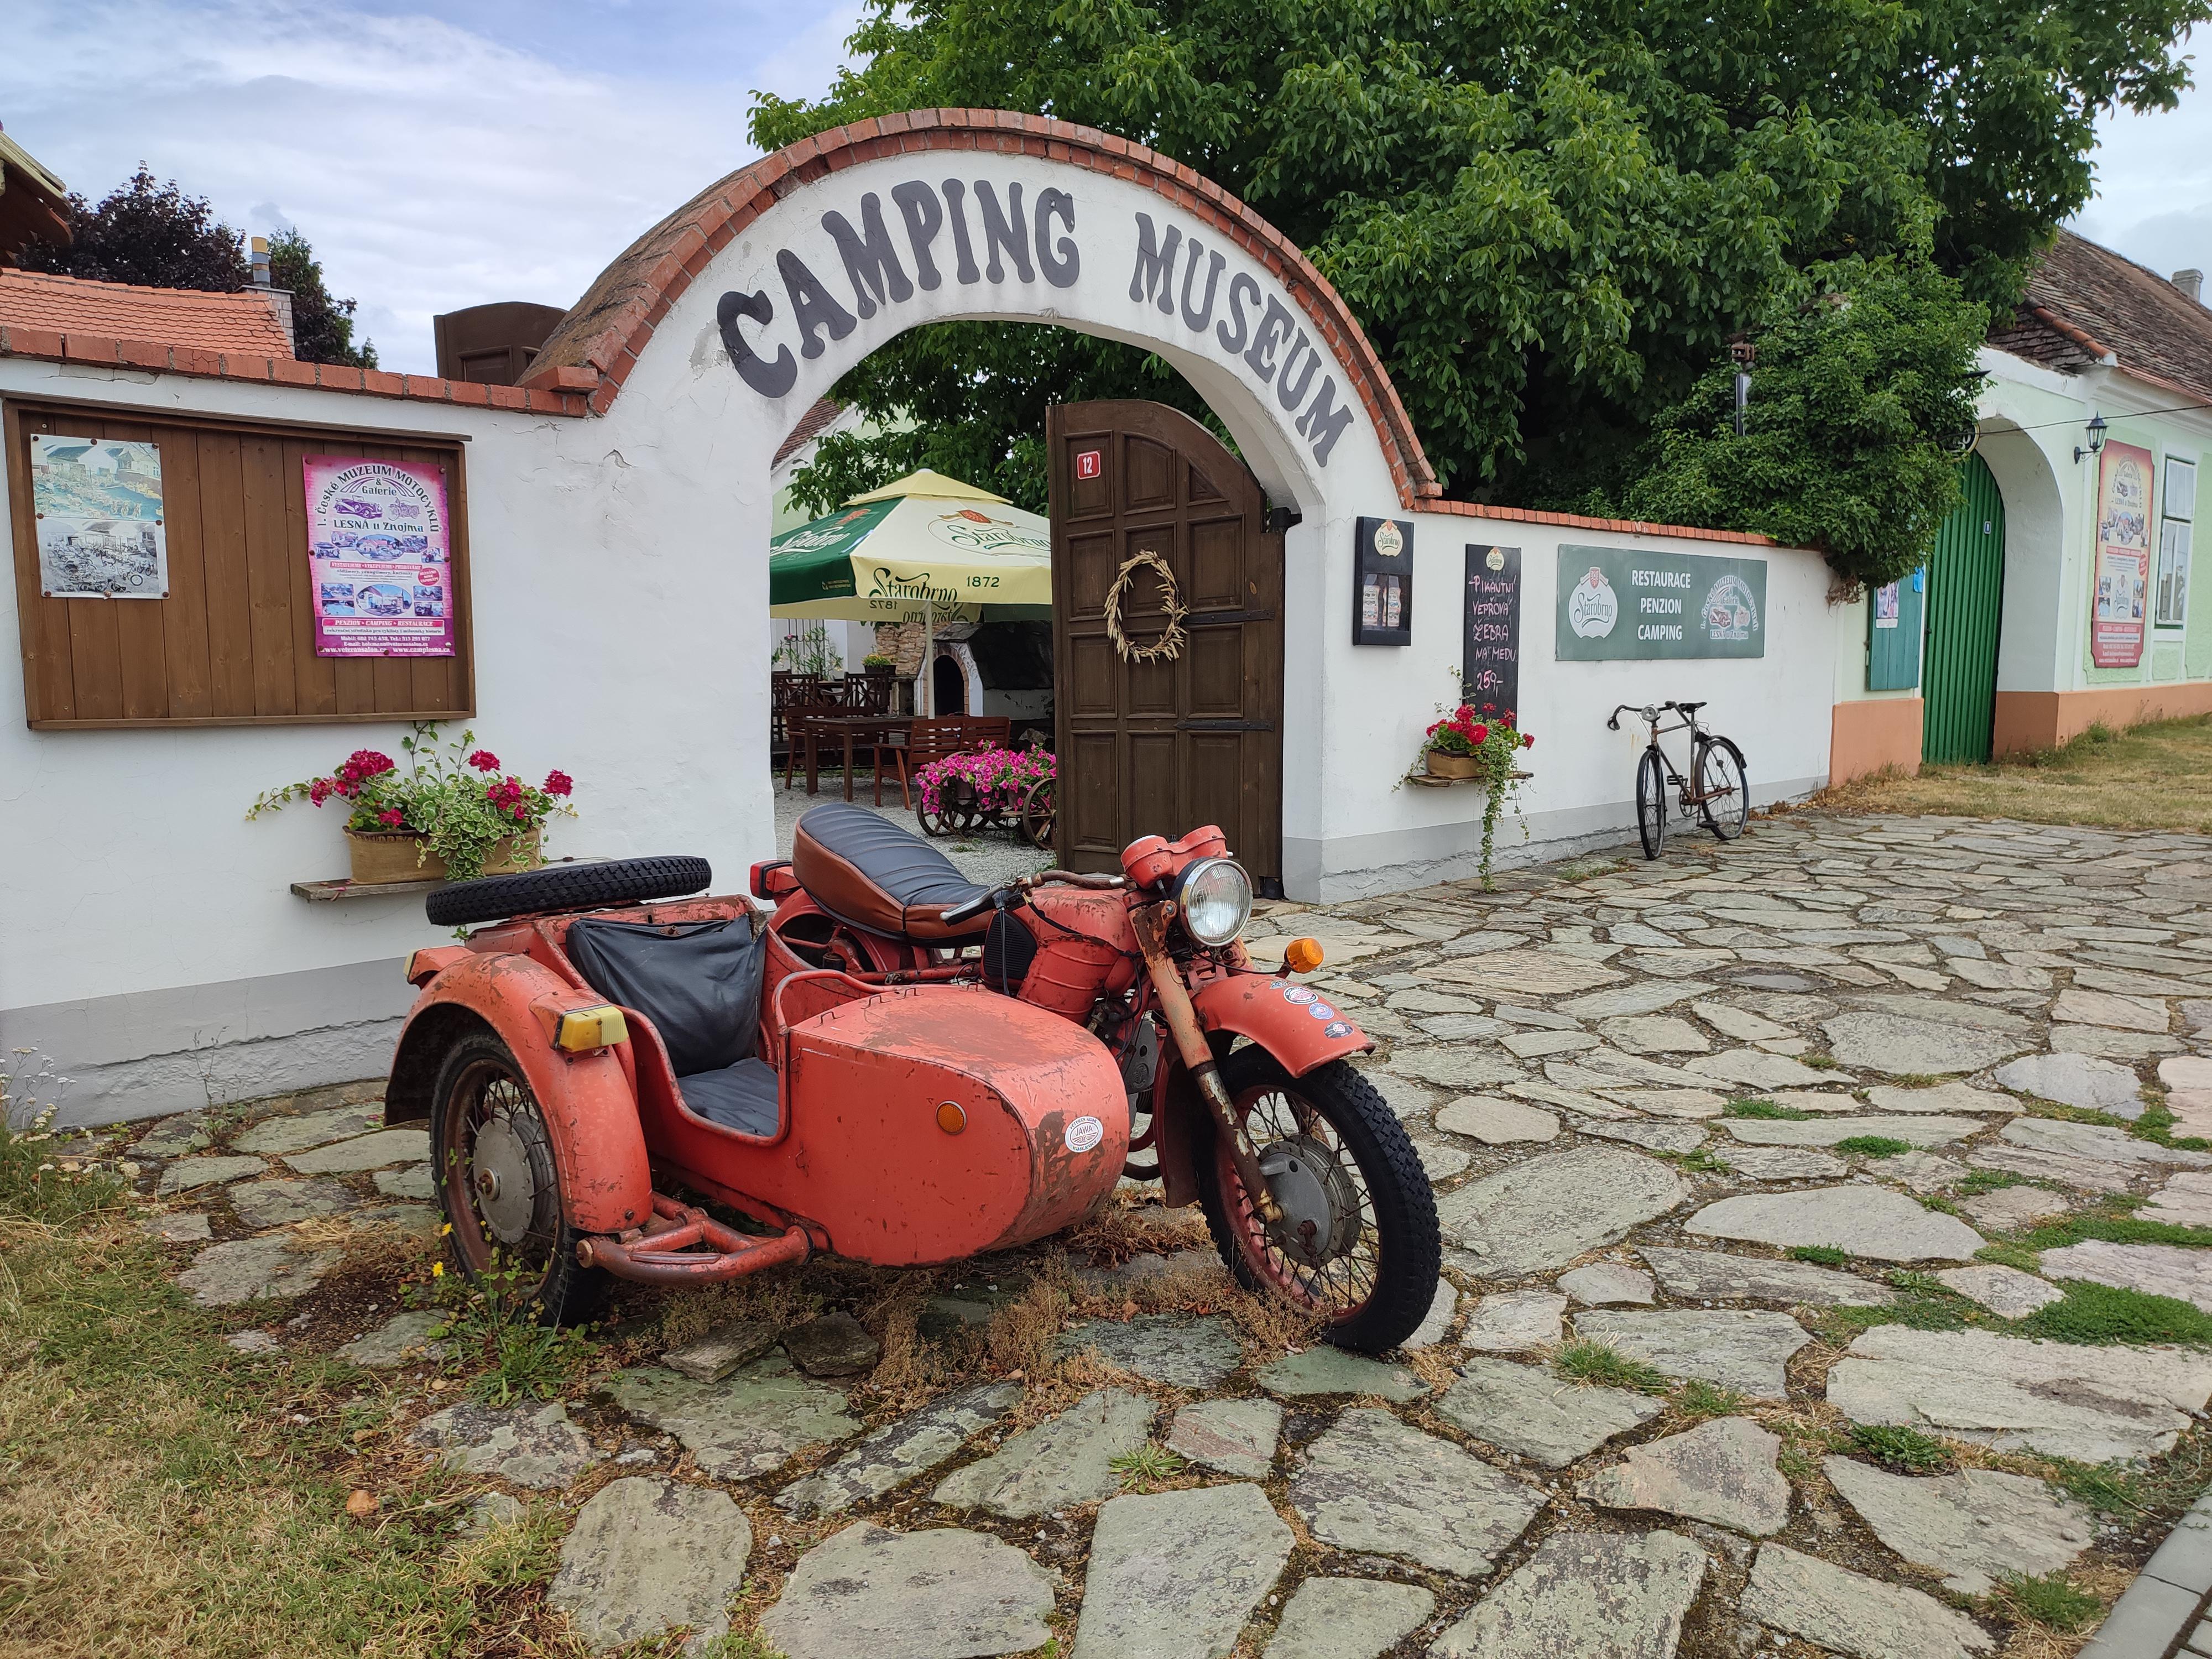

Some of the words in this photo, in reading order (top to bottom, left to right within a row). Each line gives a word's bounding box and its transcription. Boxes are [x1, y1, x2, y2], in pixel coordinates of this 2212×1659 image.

[717, 178, 1080, 398] CAMPING
[1129, 212, 1354, 467] MUSEUM
[1083, 456, 1093, 474] 12
[315, 481, 339, 515] České
[337, 465, 392, 484] MUZEUM
[395, 471, 442, 533] MOTOCYKLŮ
[362, 486, 397, 496] Galerie
[333, 519, 369, 530] LESNÁ
[383, 522, 424, 533] Znojma
[1378, 532, 1400, 550] Starobrno
[869, 567, 957, 602] Starobrno
[967, 576, 1000, 587] 1872
[1632, 570, 1691, 588] RESTAURACE
[1473, 596, 1513, 616] VEPŘOVÁ
[1574, 592, 1613, 628] Starobrno
[1640, 597, 1682, 614] PENZION
[1473, 619, 1509, 641] ŽEBRA
[1637, 624, 1682, 640] CAMPING
[1475, 648, 1488, 660] NA
[1070, 1118, 1086, 1129] VETERAN
[1076, 1125, 1093, 1136] JAWA
